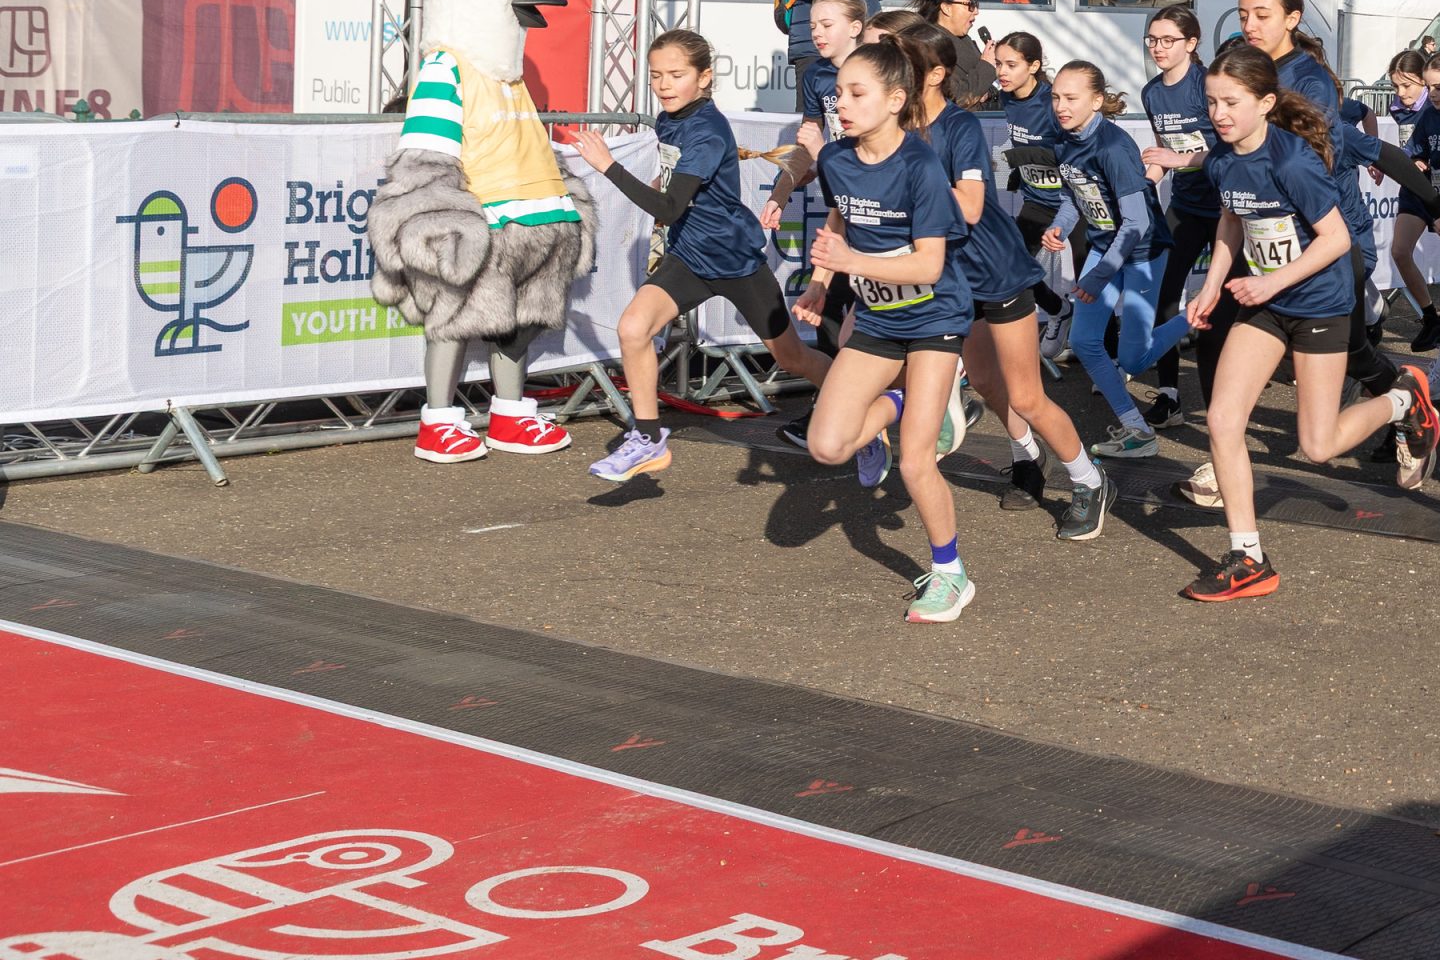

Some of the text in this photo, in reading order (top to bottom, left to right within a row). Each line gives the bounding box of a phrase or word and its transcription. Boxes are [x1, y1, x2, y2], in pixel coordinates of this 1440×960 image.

[712, 54, 797, 91] Public
[311, 77, 361, 105] Public
[1023, 166, 1058, 185] 3676
[285, 178, 387, 234] Brig
[849, 197, 881, 208] Brighton
[866, 208, 907, 218] Marathon
[1250, 239, 1292, 265] 147
[291, 307, 377, 337] YOUTH
